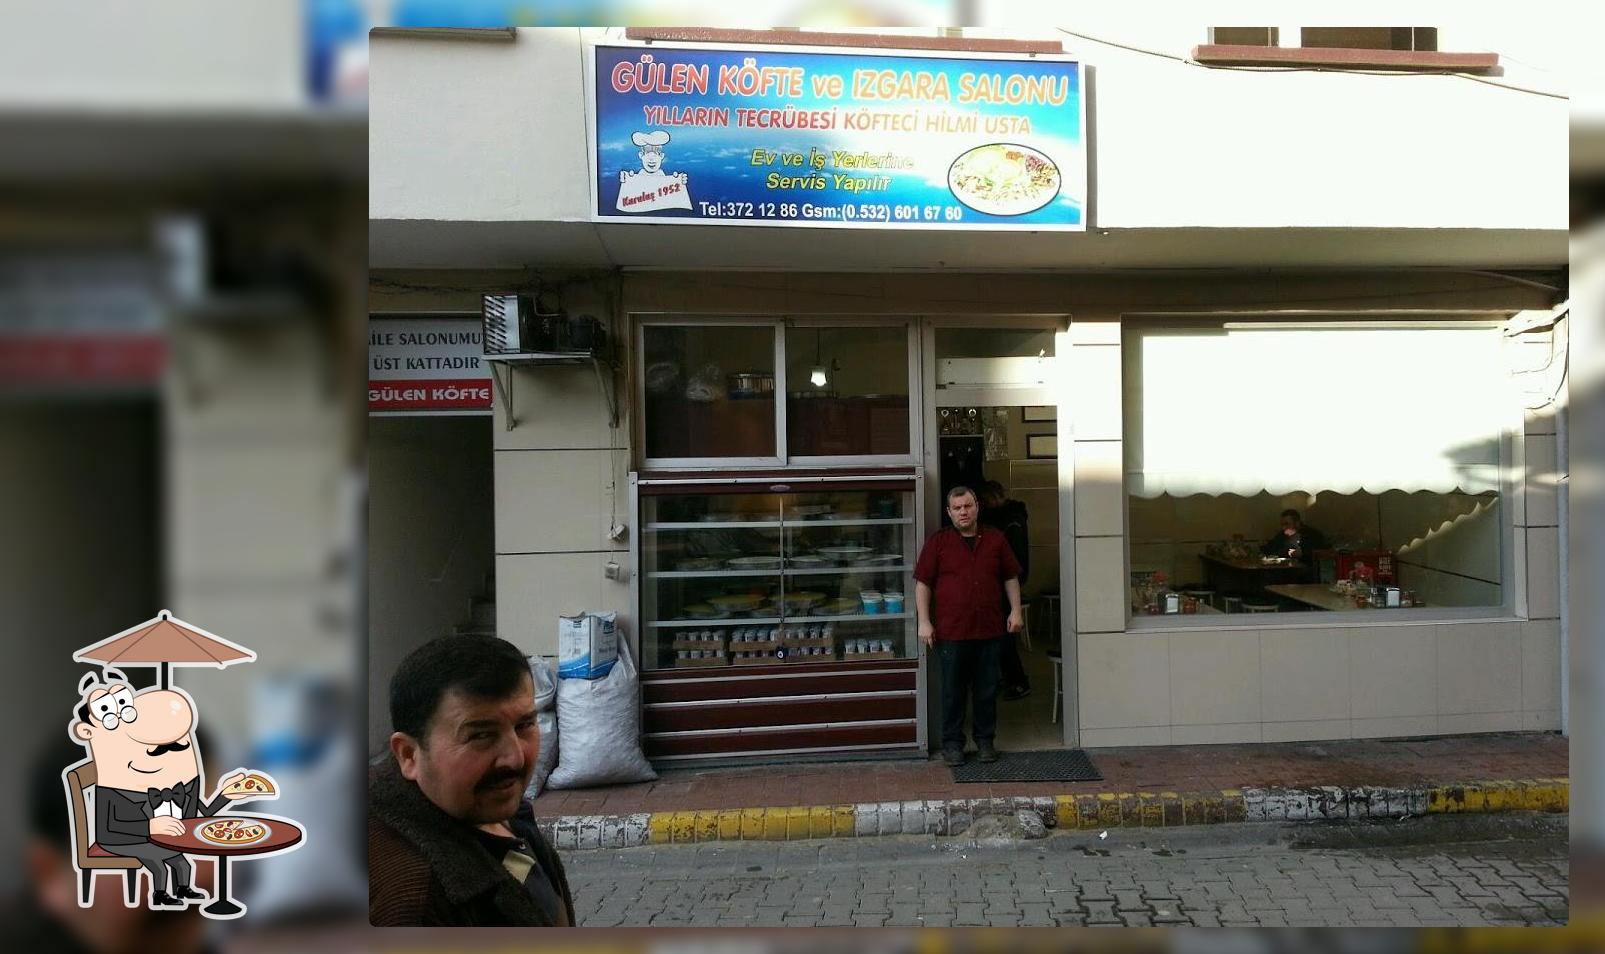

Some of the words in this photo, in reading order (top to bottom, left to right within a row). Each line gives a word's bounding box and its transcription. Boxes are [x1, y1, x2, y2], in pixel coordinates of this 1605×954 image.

[611, 54, 709, 95] GÜLEN
[718, 57, 805, 97] KÖFTE
[811, 74, 844, 98] ve
[852, 68, 950, 101] IZGARA
[959, 72, 1069, 105] SALONU
[643, 106, 729, 127] YILLARIN
[736, 105, 838, 130] TECRÜBESİ
[844, 107, 919, 132] KÖFTECİ
[925, 110, 978, 134] HİLMİ
[984, 116, 1032, 135] USTA
[751, 148, 777, 166] Ev
[782, 153, 804, 166] ve
[809, 147, 826, 170] İş
[832, 150, 915, 169] Yerlerine
[658, 183, 681, 197] 1952
[766, 172, 826, 190] Servis
[698, 201, 754, 217] Tel:372
[758, 203, 776, 218] 12
[780, 203, 798, 218] 86
[894, 205, 920, 221] 601
[923, 206, 941, 221] 67
[945, 206, 963, 221] 60
[368, 331, 394, 345] İLE
[399, 333, 485, 345] SALONUMU
[374, 355, 400, 370] ÜST
[406, 357, 480, 369] KATTADIR
[368, 386, 426, 401] GÜLEN
[432, 386, 490, 400] KÖFTE
